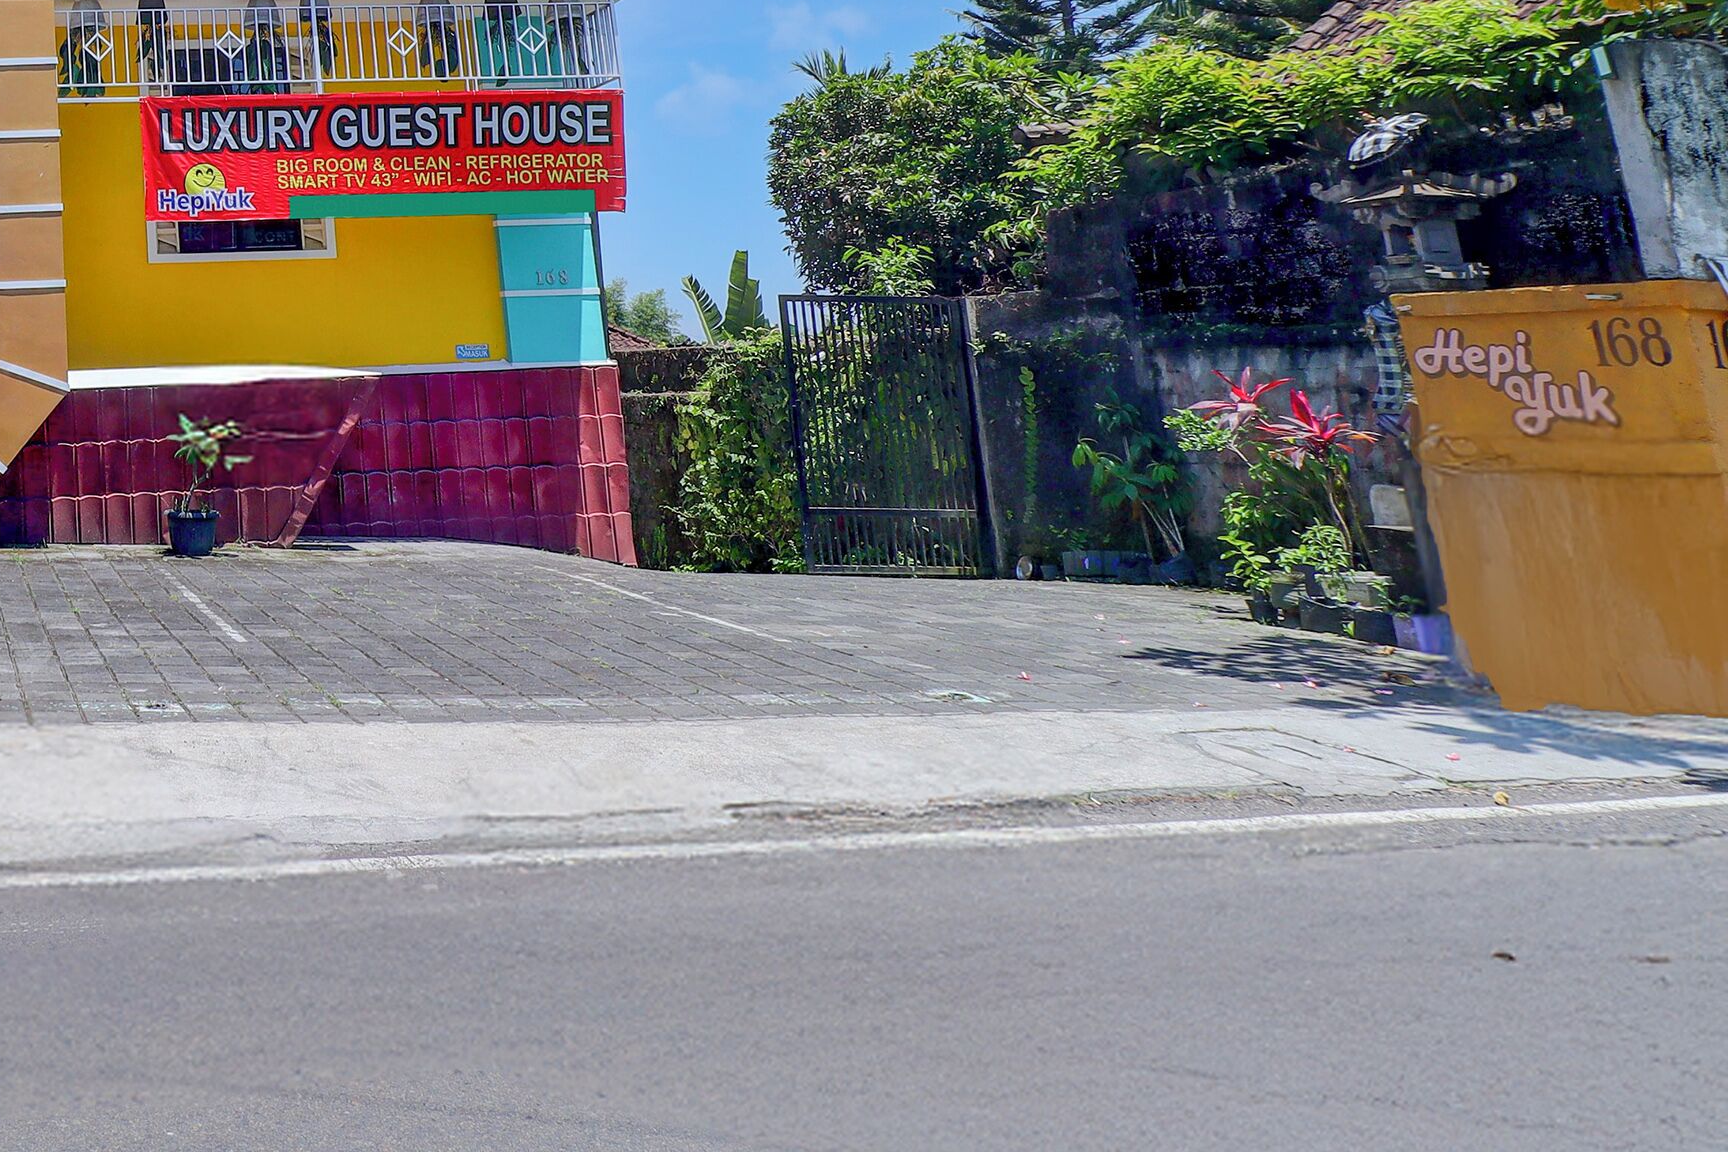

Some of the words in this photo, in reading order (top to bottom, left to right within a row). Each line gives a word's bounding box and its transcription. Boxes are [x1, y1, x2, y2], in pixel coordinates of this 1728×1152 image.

[160, 107, 320, 152] LUXURY
[329, 104, 463, 148] GUEST
[474, 102, 611, 146] HOUSE
[276, 159, 308, 173] BIG
[313, 158, 367, 172] ROOM
[373, 157, 385, 171] &
[390, 156, 450, 171] CLEAN
[466, 153, 603, 169] REFRIGERATOR
[277, 173, 338, 189] SMART
[343, 173, 366, 188] TV
[414, 171, 452, 186] WIFI
[467, 170, 491, 185] AC
[506, 170, 542, 184] HOT
[547, 168, 609, 183] WATER
[158, 189, 254, 216] HepiYuk
[536, 269, 569, 285] 168
[464, 350, 488, 358] MASUK
[1587, 317, 1672, 367] 168
[1414, 328, 1534, 388] Hepi
